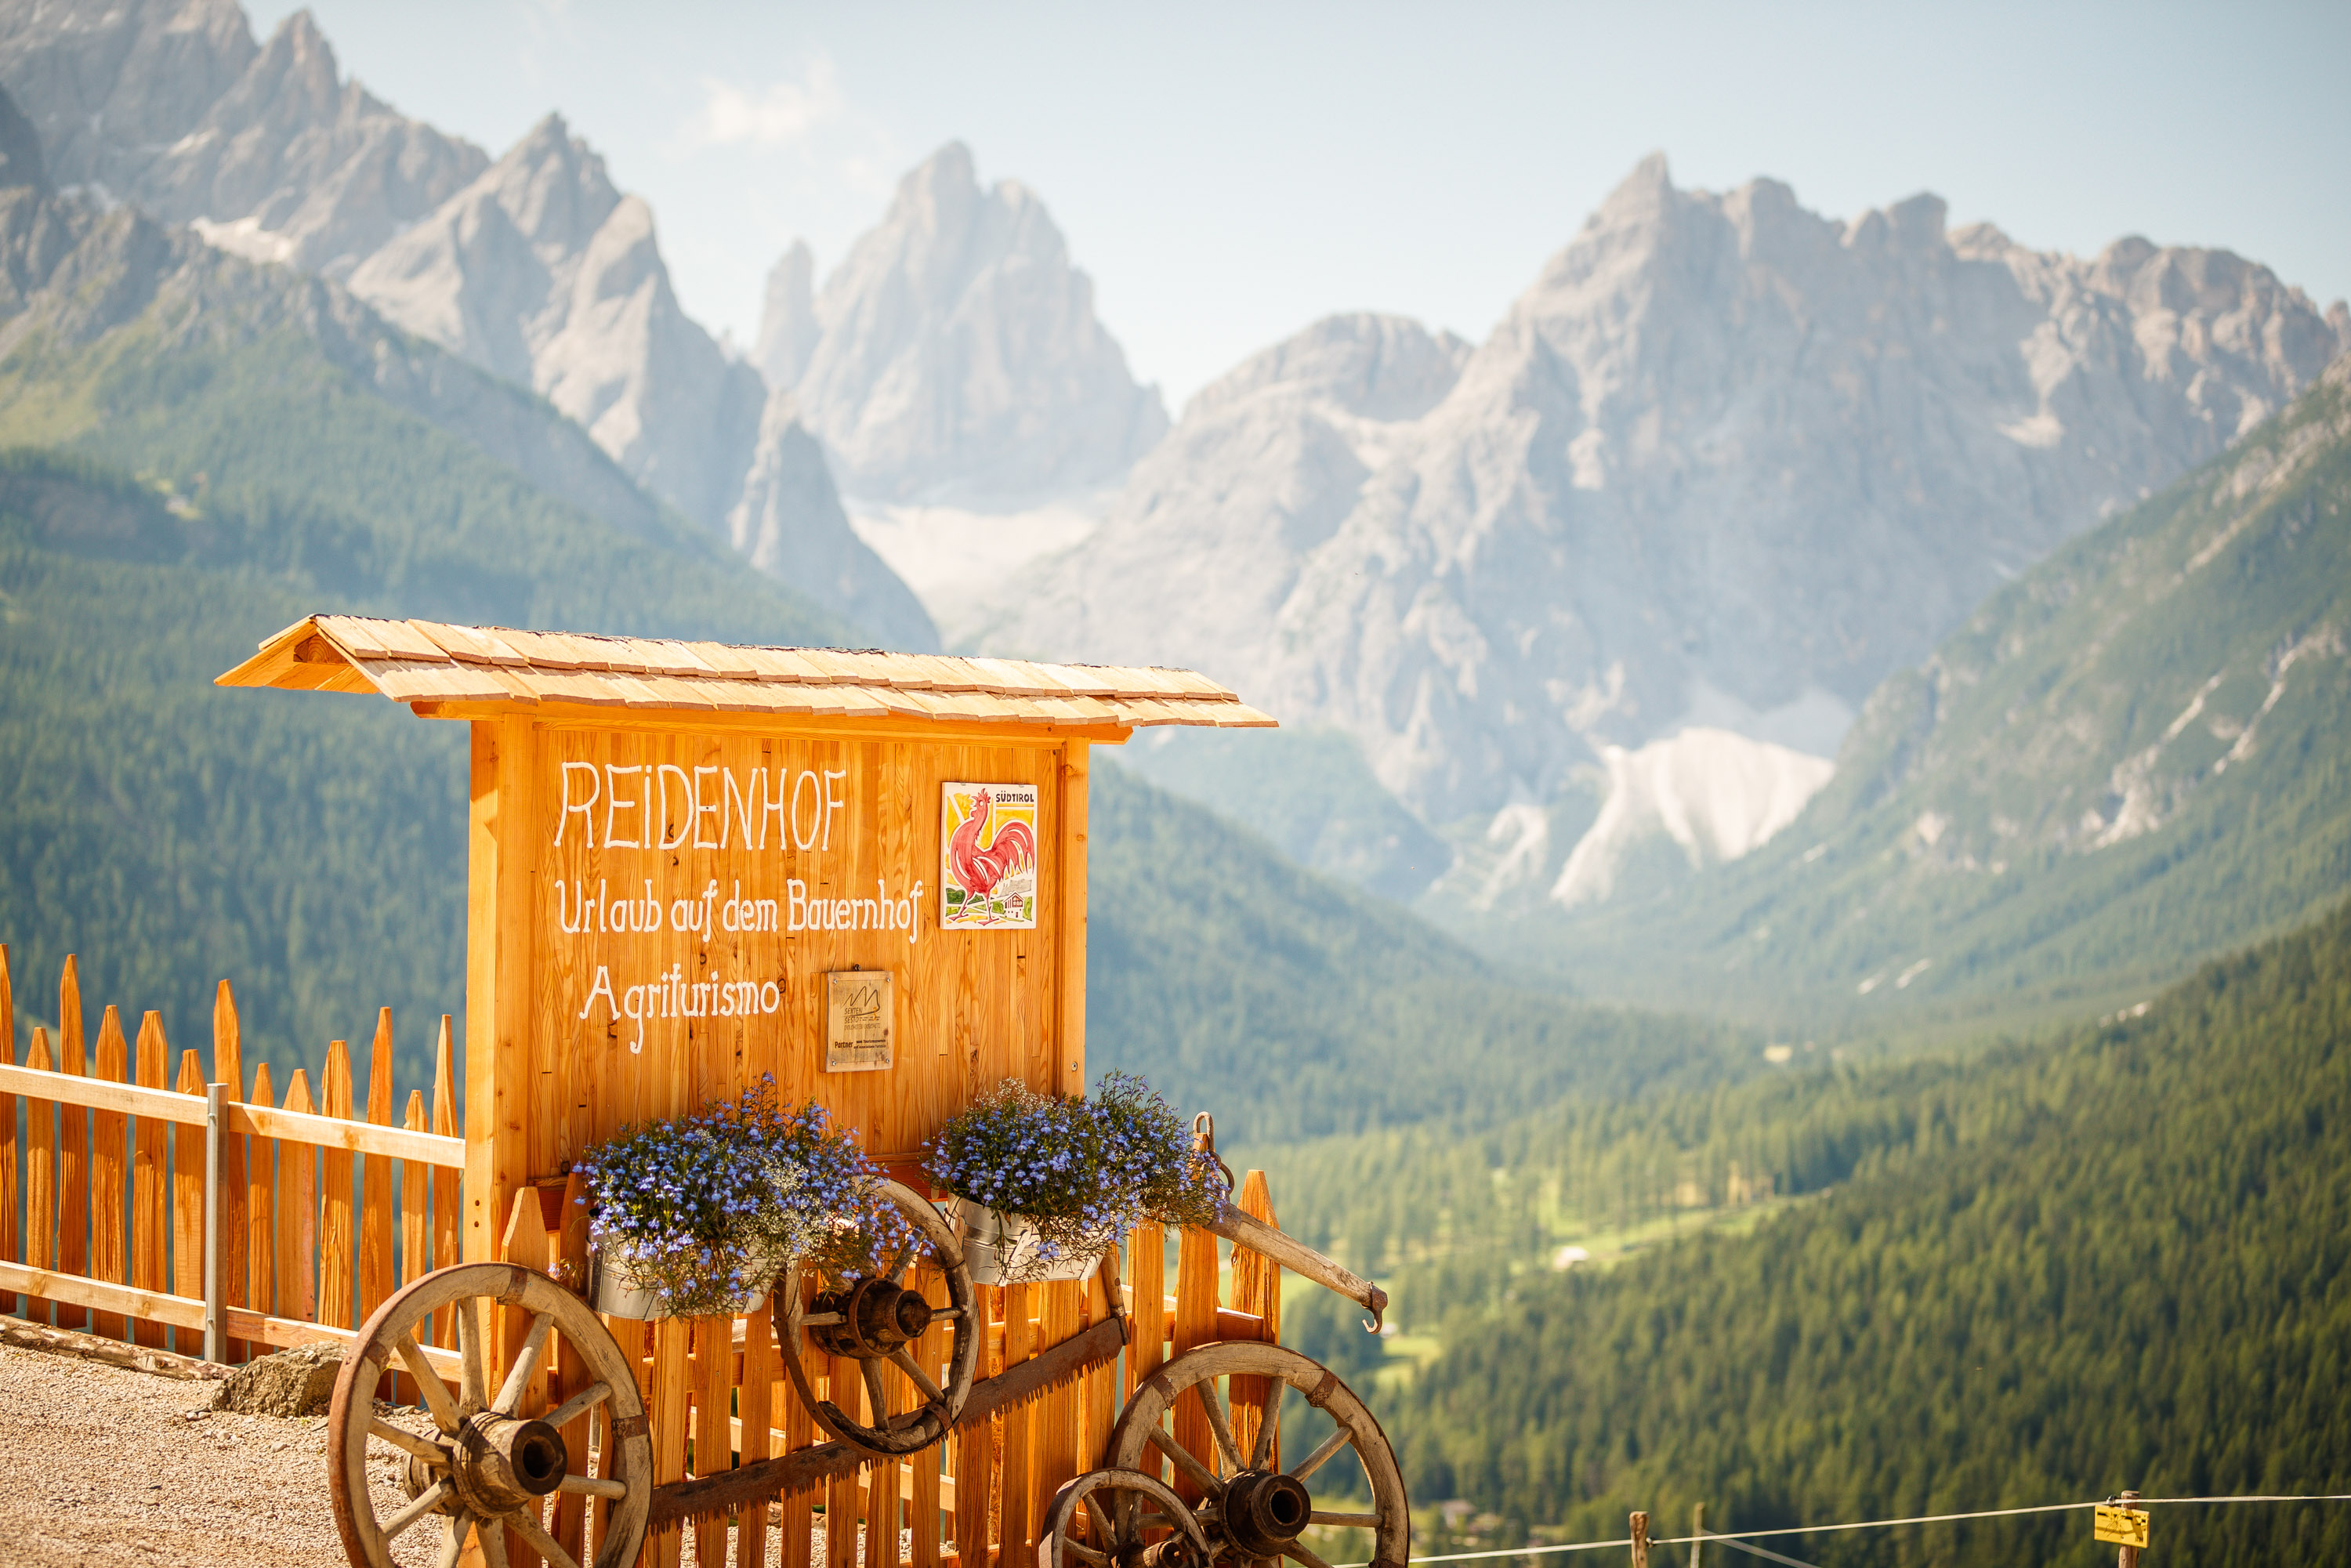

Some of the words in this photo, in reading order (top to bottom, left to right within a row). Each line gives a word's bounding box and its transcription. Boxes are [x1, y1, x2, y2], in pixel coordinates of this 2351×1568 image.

[995, 791, 1034, 803] SÜDTIROL
[555, 878, 662, 933] Urlaub
[670, 878, 719, 942] auf
[723, 878, 778, 932] dem
[787, 878, 924, 943] Bauernhof
[579, 963, 780, 1054] Agriturismo
